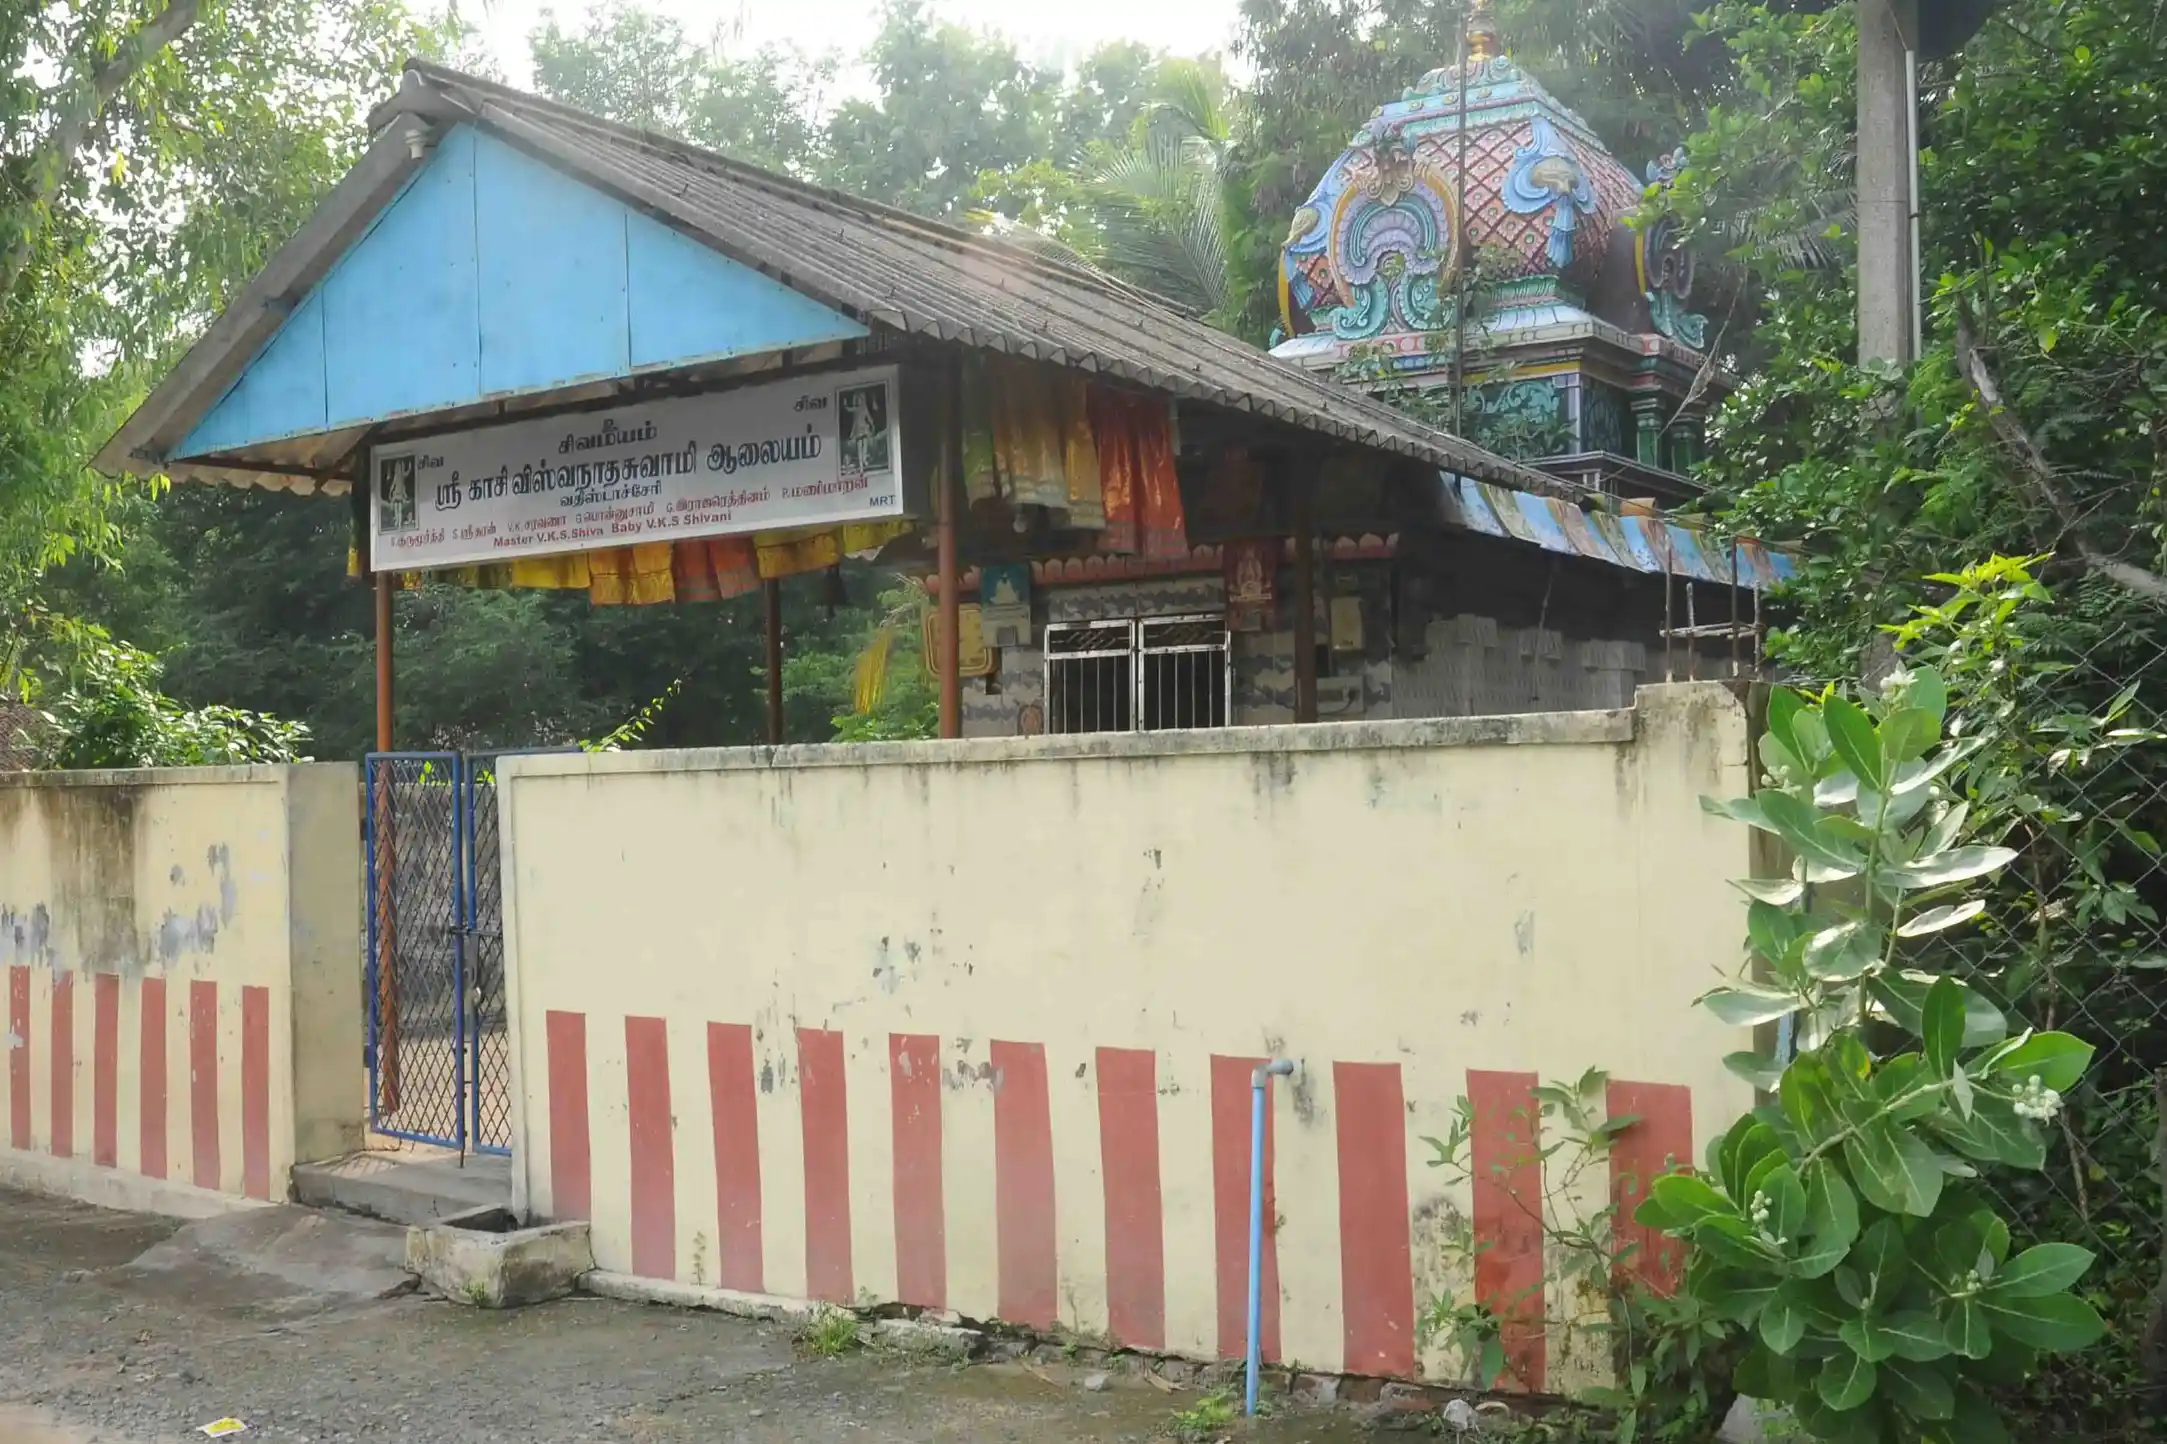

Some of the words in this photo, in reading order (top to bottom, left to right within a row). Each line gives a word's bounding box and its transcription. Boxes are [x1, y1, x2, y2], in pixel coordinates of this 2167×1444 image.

[794, 394, 828, 412] சிவ
[558, 421, 658, 454] சிவமயம்
[416, 454, 444, 470] சிவ
[435, 471, 462, 511] ஸ்ரீ
[468, 465, 508, 501] காசி
[869, 494, 896, 507] MRT
[493, 533, 533, 548] Master
[611, 520, 642, 534] Baby
[684, 510, 732, 526] Shivani
